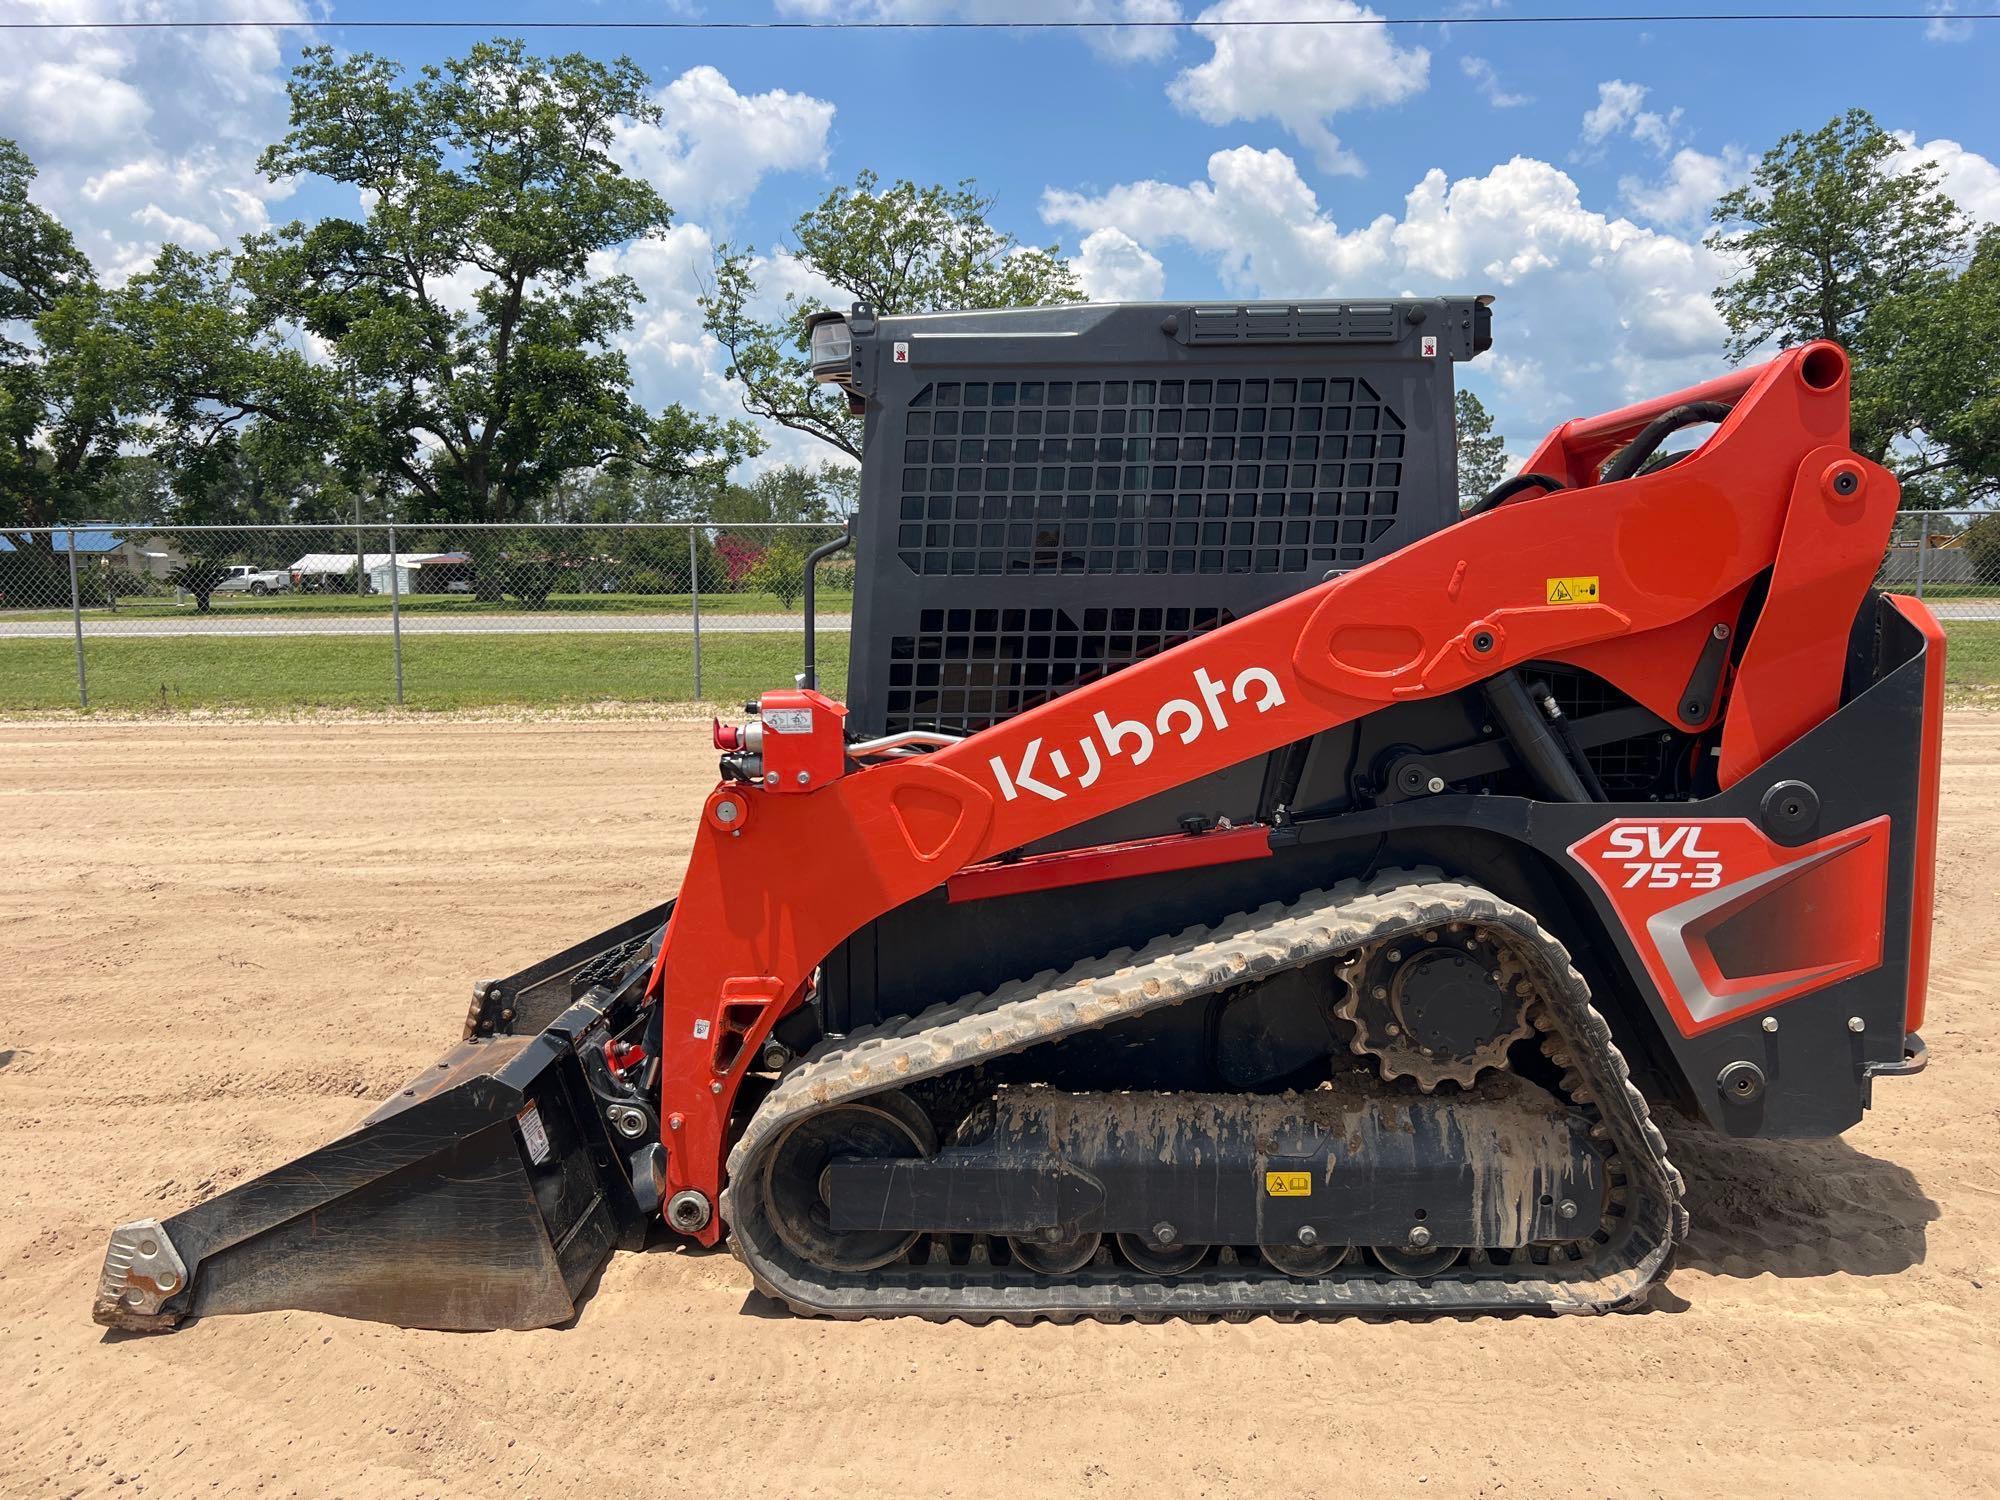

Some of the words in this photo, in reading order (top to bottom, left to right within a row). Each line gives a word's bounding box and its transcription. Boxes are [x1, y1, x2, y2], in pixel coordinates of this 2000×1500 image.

[988, 667, 1286, 802] Kubota
[1601, 826, 1720, 859] SVL
[1622, 862, 1723, 889] 75-3
